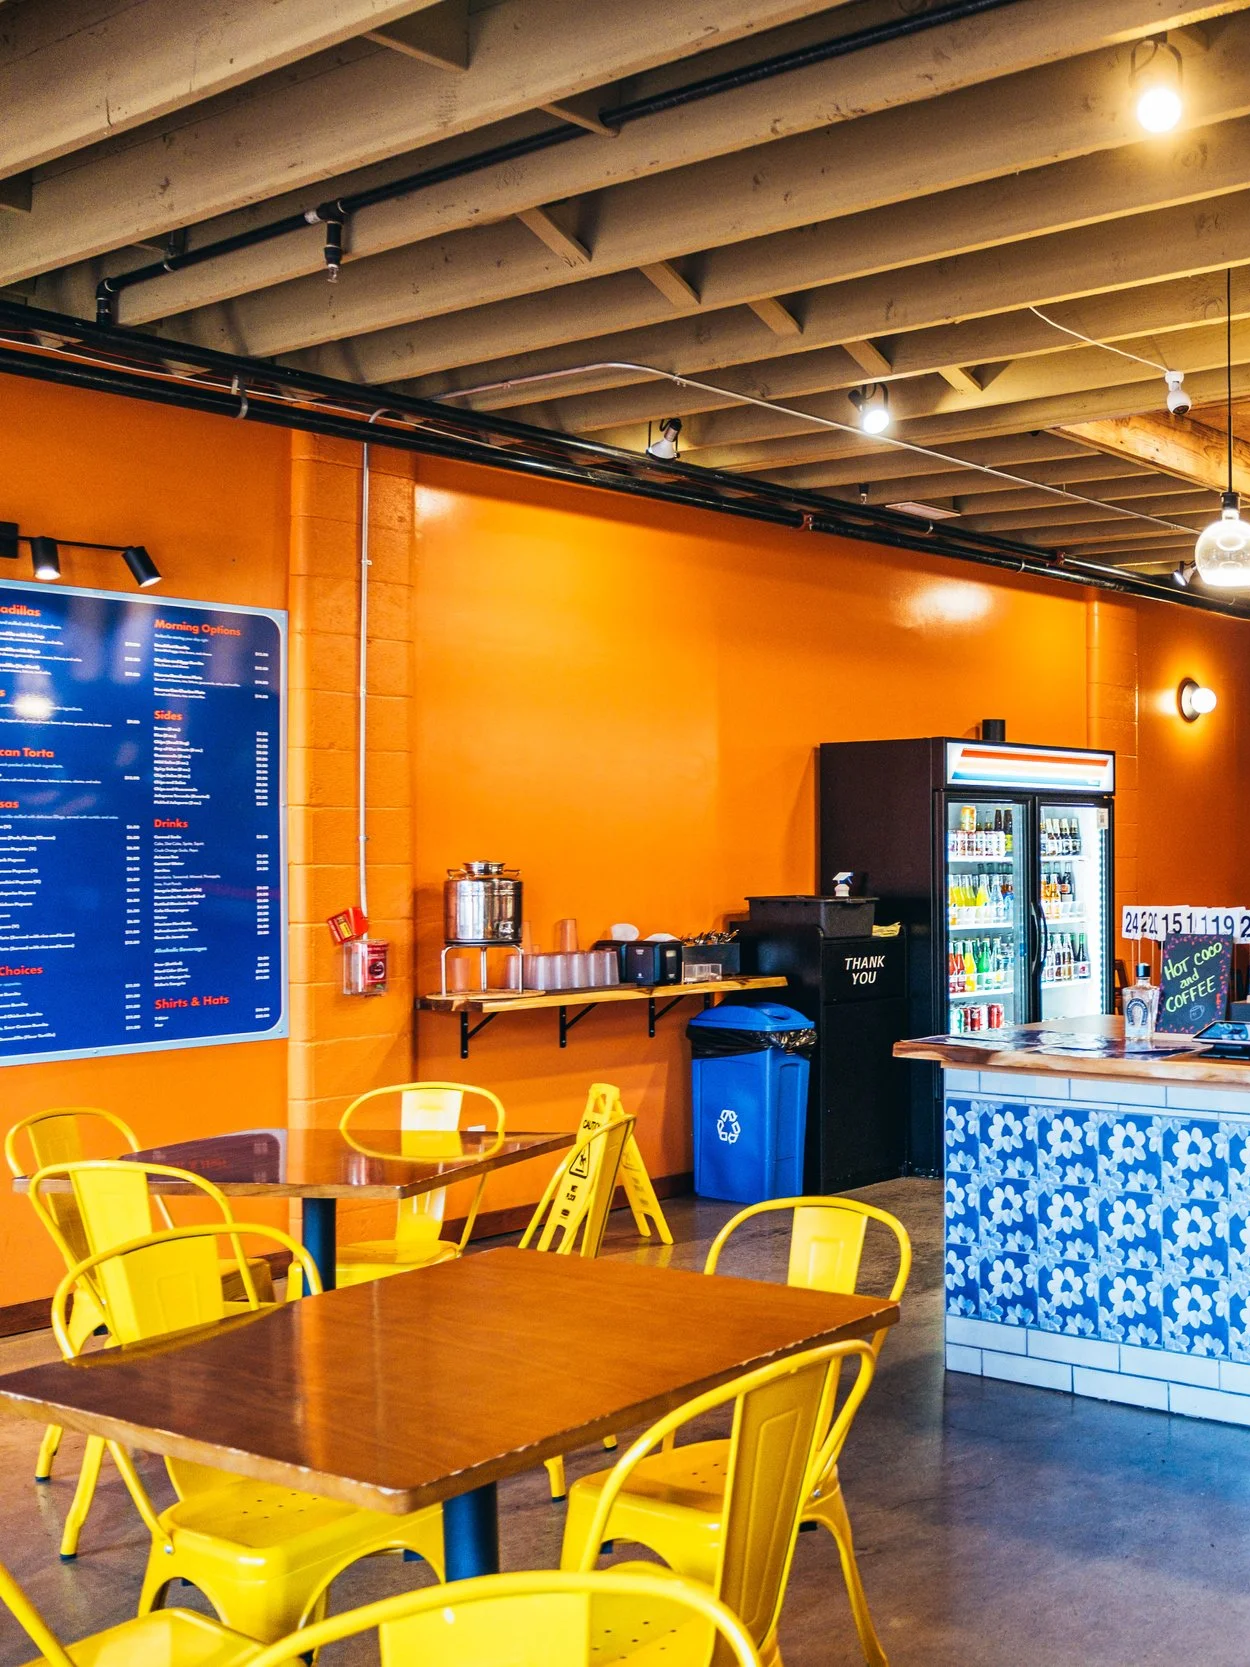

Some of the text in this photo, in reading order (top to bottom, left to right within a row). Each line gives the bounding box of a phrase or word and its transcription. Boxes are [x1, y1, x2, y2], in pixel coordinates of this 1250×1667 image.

[0, 604, 41, 617] adillas
[154, 619, 241, 637] Morning Options
[154, 710, 183, 721] Sides
[22, 747, 54, 758] Torta
[154, 818, 189, 829] Drinks
[1125, 911, 1138, 934] 24
[1141, 911, 1148, 933] 2
[1162, 912, 1182, 935] 15
[1211, 914, 1234, 936] 19
[0, 965, 43, 976] Choices
[844, 955, 886, 971] THANK
[1164, 956, 1190, 981] HOT
[852, 971, 877, 985] YOU
[1179, 967, 1200, 989] and
[154, 995, 230, 1010] Shirts & Hats
[1165, 975, 1216, 1013] COFFEE
